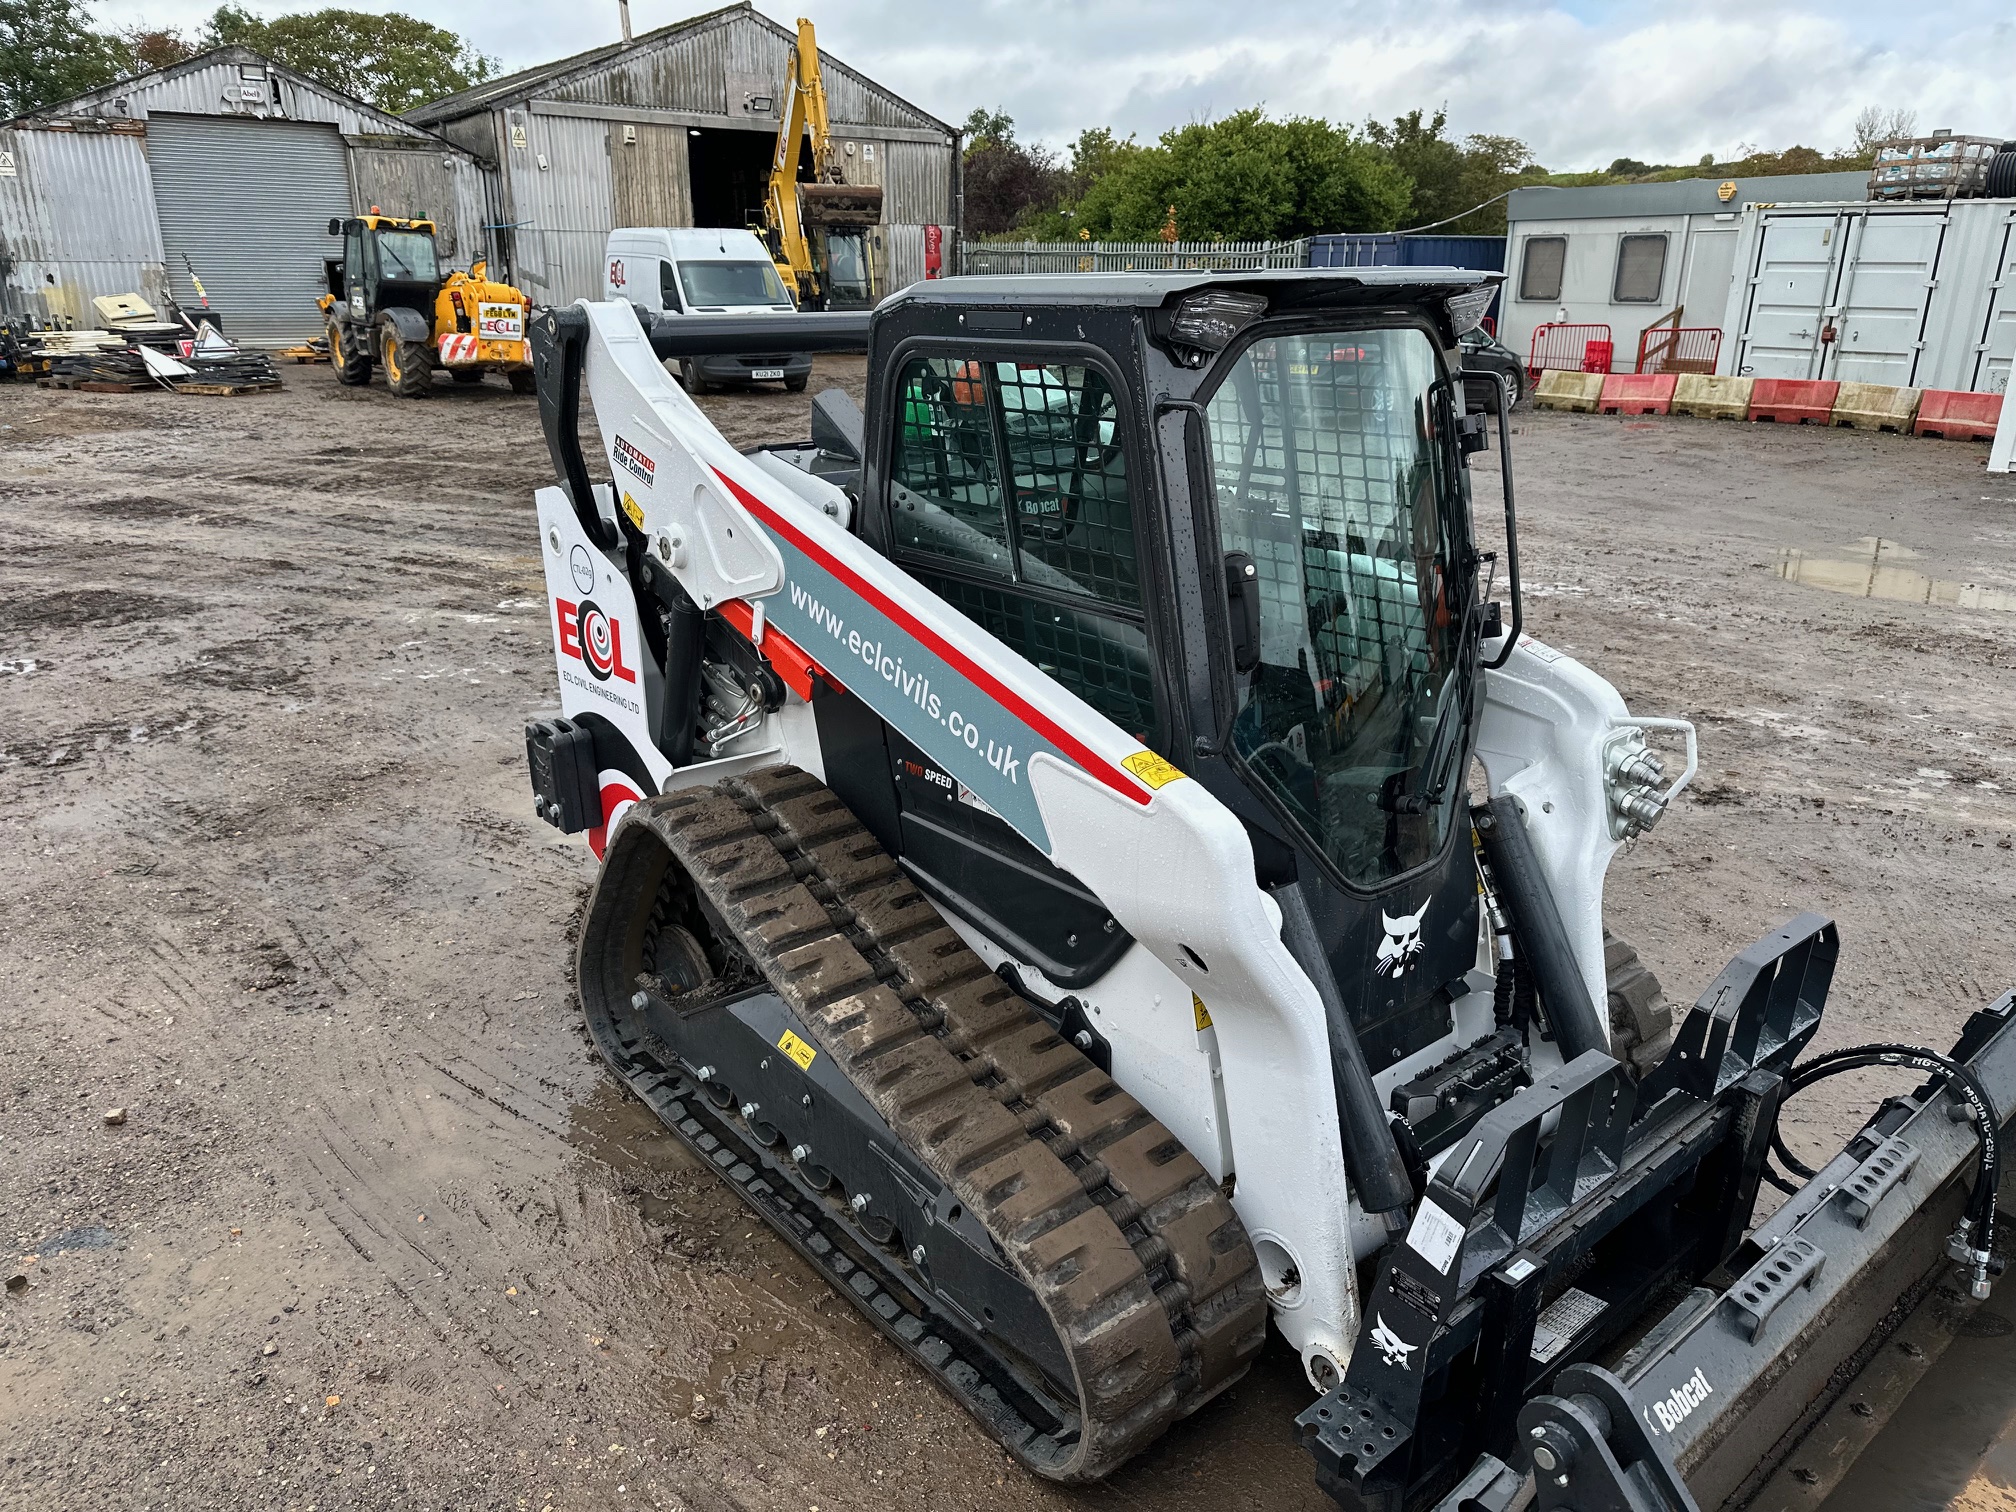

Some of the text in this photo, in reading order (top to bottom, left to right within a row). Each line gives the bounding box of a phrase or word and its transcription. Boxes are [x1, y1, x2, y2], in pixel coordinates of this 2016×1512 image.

[610, 259, 626, 289] ECL
[613, 445, 654, 487] Ride Control
[616, 437, 655, 471] AUTOMATIC
[556, 597, 636, 685] ECL
[563, 670, 640, 715] ECL CIVIL ENGINEERING LTD
[790, 580, 1020, 785] www.eclcivils.co.uk
[905, 761, 953, 789] TWO SPEED
[1653, 1366, 1714, 1433] Bobcat
